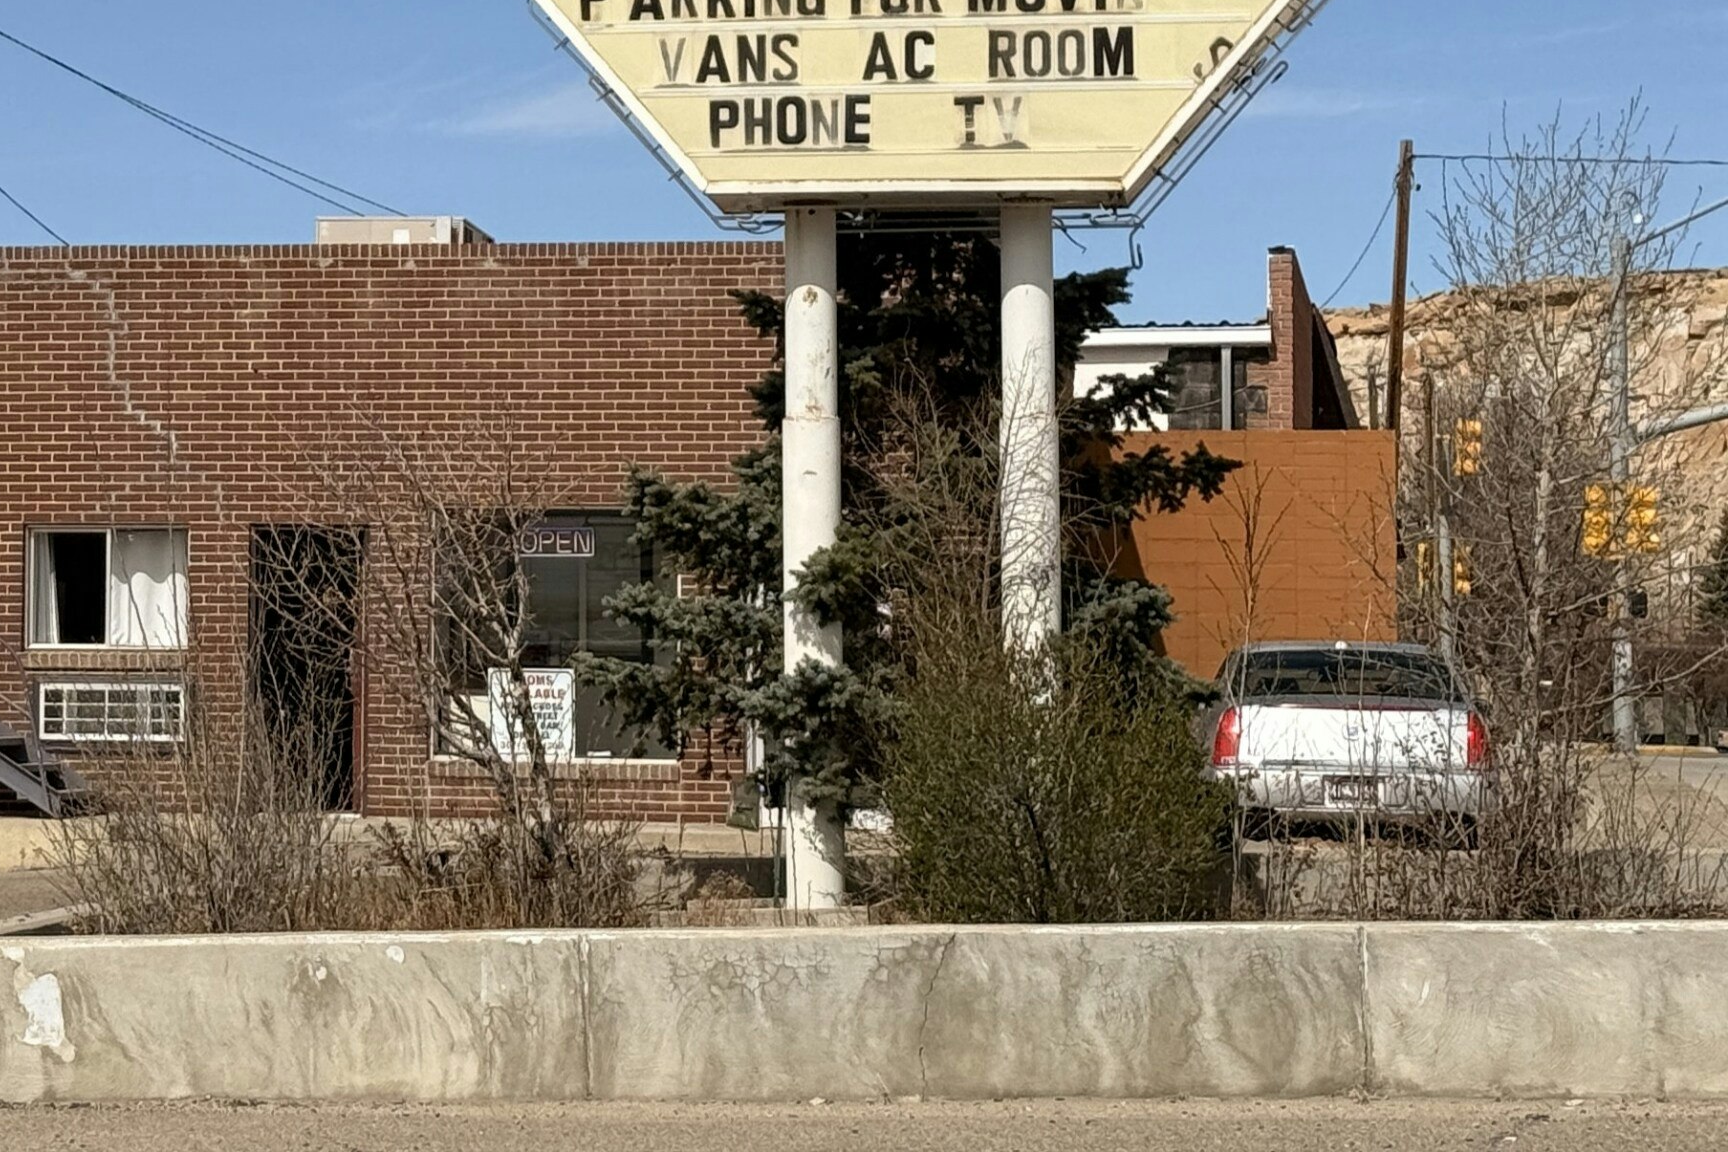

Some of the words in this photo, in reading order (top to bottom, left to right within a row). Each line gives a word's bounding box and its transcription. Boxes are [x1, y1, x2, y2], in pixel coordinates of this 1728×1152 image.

[659, 33, 799, 83] VANS
[862, 30, 935, 81] AC
[988, 26, 1134, 78] ROOM
[709, 94, 871, 148] PHONE
[954, 95, 1022, 143] TV
[521, 531, 590, 553] OPEN
